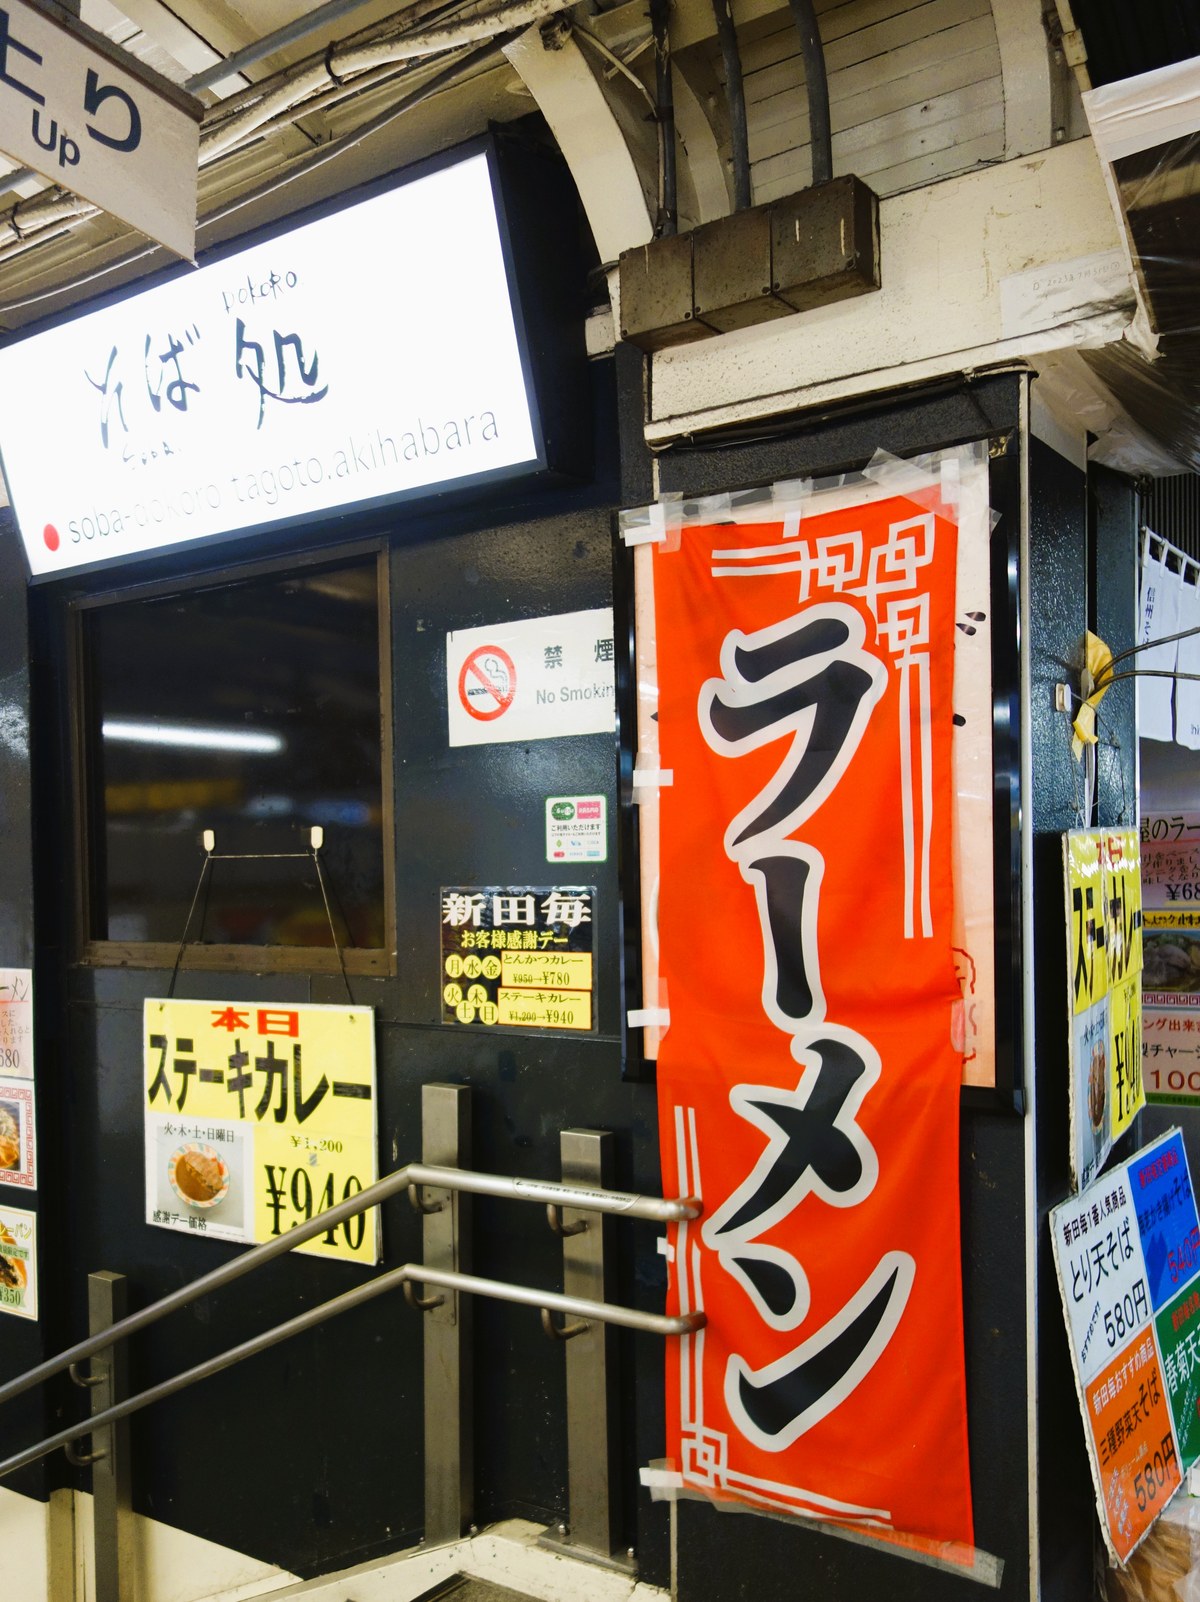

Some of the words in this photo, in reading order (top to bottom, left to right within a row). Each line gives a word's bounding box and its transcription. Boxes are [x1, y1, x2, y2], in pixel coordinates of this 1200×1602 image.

[31, 108, 81, 168] Up
[230, 410, 500, 505] tagoto.akihabara
[543, 637, 614, 670] 禁煙
[536, 689, 556, 704] No
[442, 892, 593, 928] 新田毎
[461, 929, 569, 950] お客様感謝デー
[503, 953, 584, 965] とんかつカレー
[542, 971, 570, 986] ¥780
[500, 991, 582, 1004] ステーキカレー
[210, 1006, 300, 1038] 本日
[545, 1009, 574, 1025] ¥940
[698, 597, 916, 1452] ラーメン
[148, 1034, 372, 1125] ステーキカレー
[152, 1209, 208, 1232] 感謝デー価格
[263, 1164, 366, 1251] ¥940
[1069, 1216, 1135, 1303] とり天そば
[1103, 1277, 1149, 1349] 580円
[1099, 1366, 1161, 1467] 三種野菜天そば
[1133, 1430, 1178, 1513] 580円
